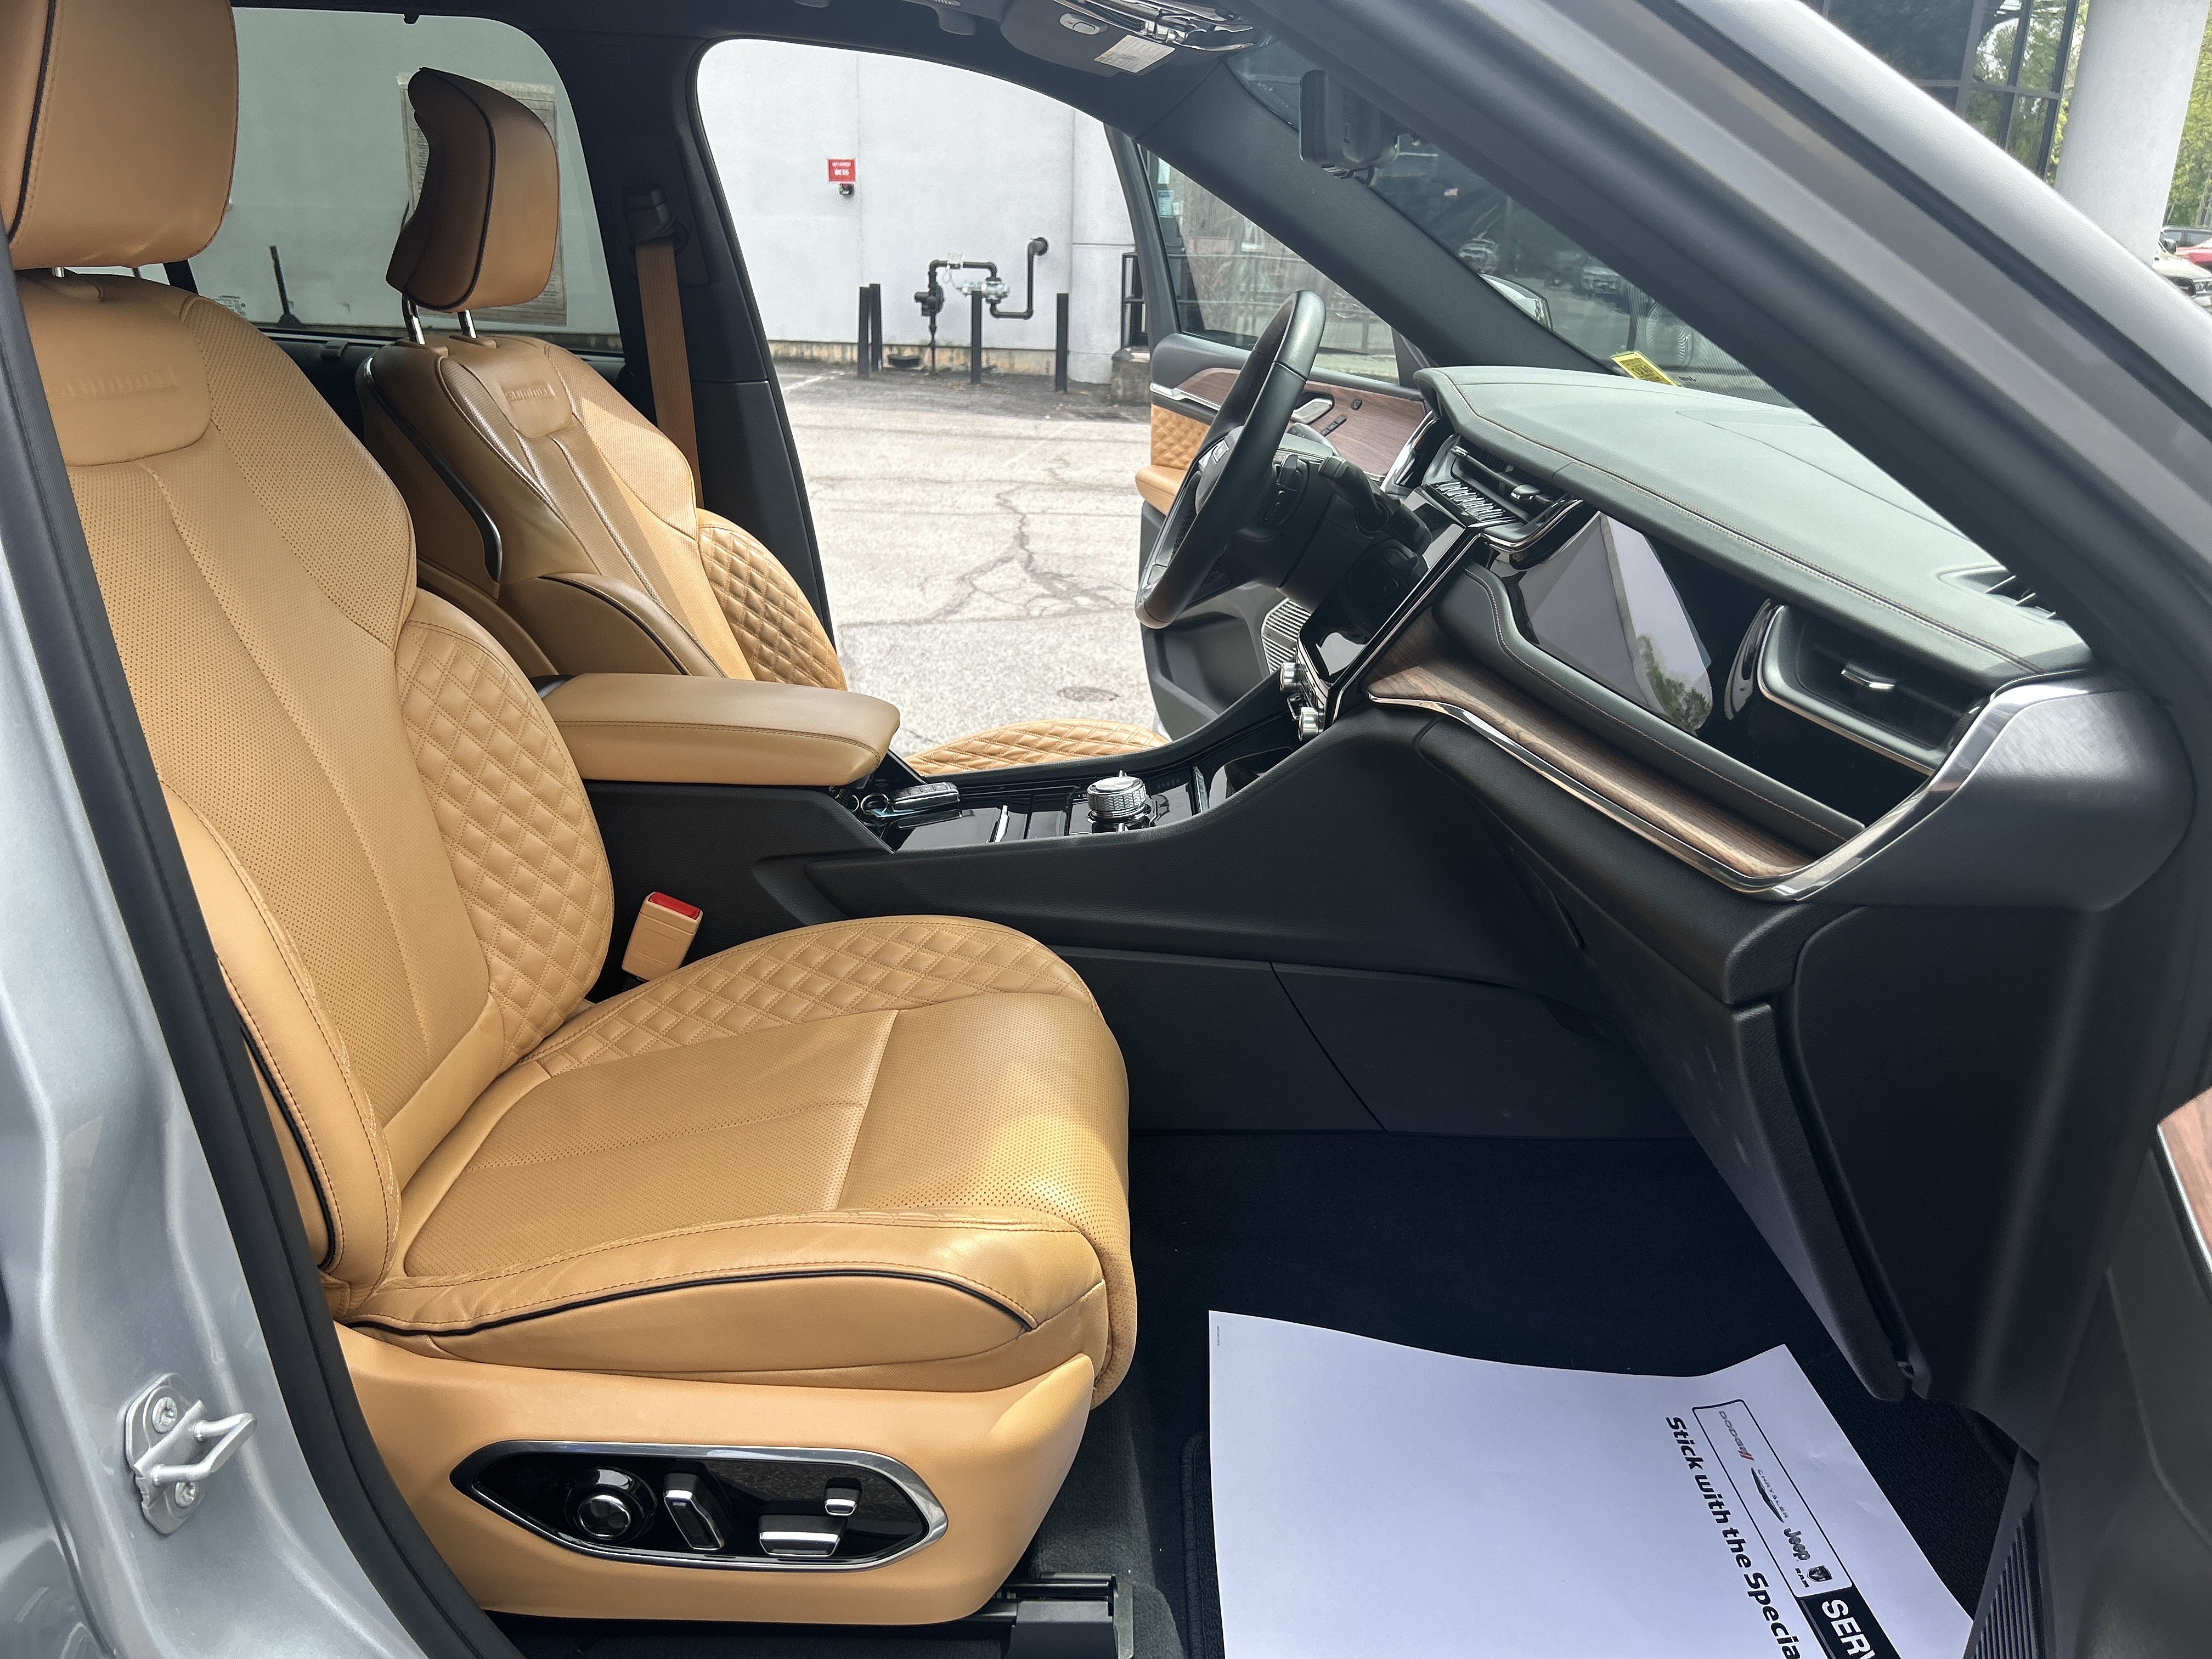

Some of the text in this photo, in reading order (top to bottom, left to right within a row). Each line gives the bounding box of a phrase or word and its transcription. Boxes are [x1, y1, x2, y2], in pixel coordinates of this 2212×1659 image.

[1719, 1410, 1748, 1455] DODGE
[1666, 1417, 1704, 1470] Stick
[1694, 1474, 1731, 1524] with
[1722, 1527, 1752, 1568] the
[1758, 1469, 1788, 1519] CHRYSLER
[1783, 1527, 1811, 1560] Jeep
[1795, 1567, 1810, 1588] RAM
